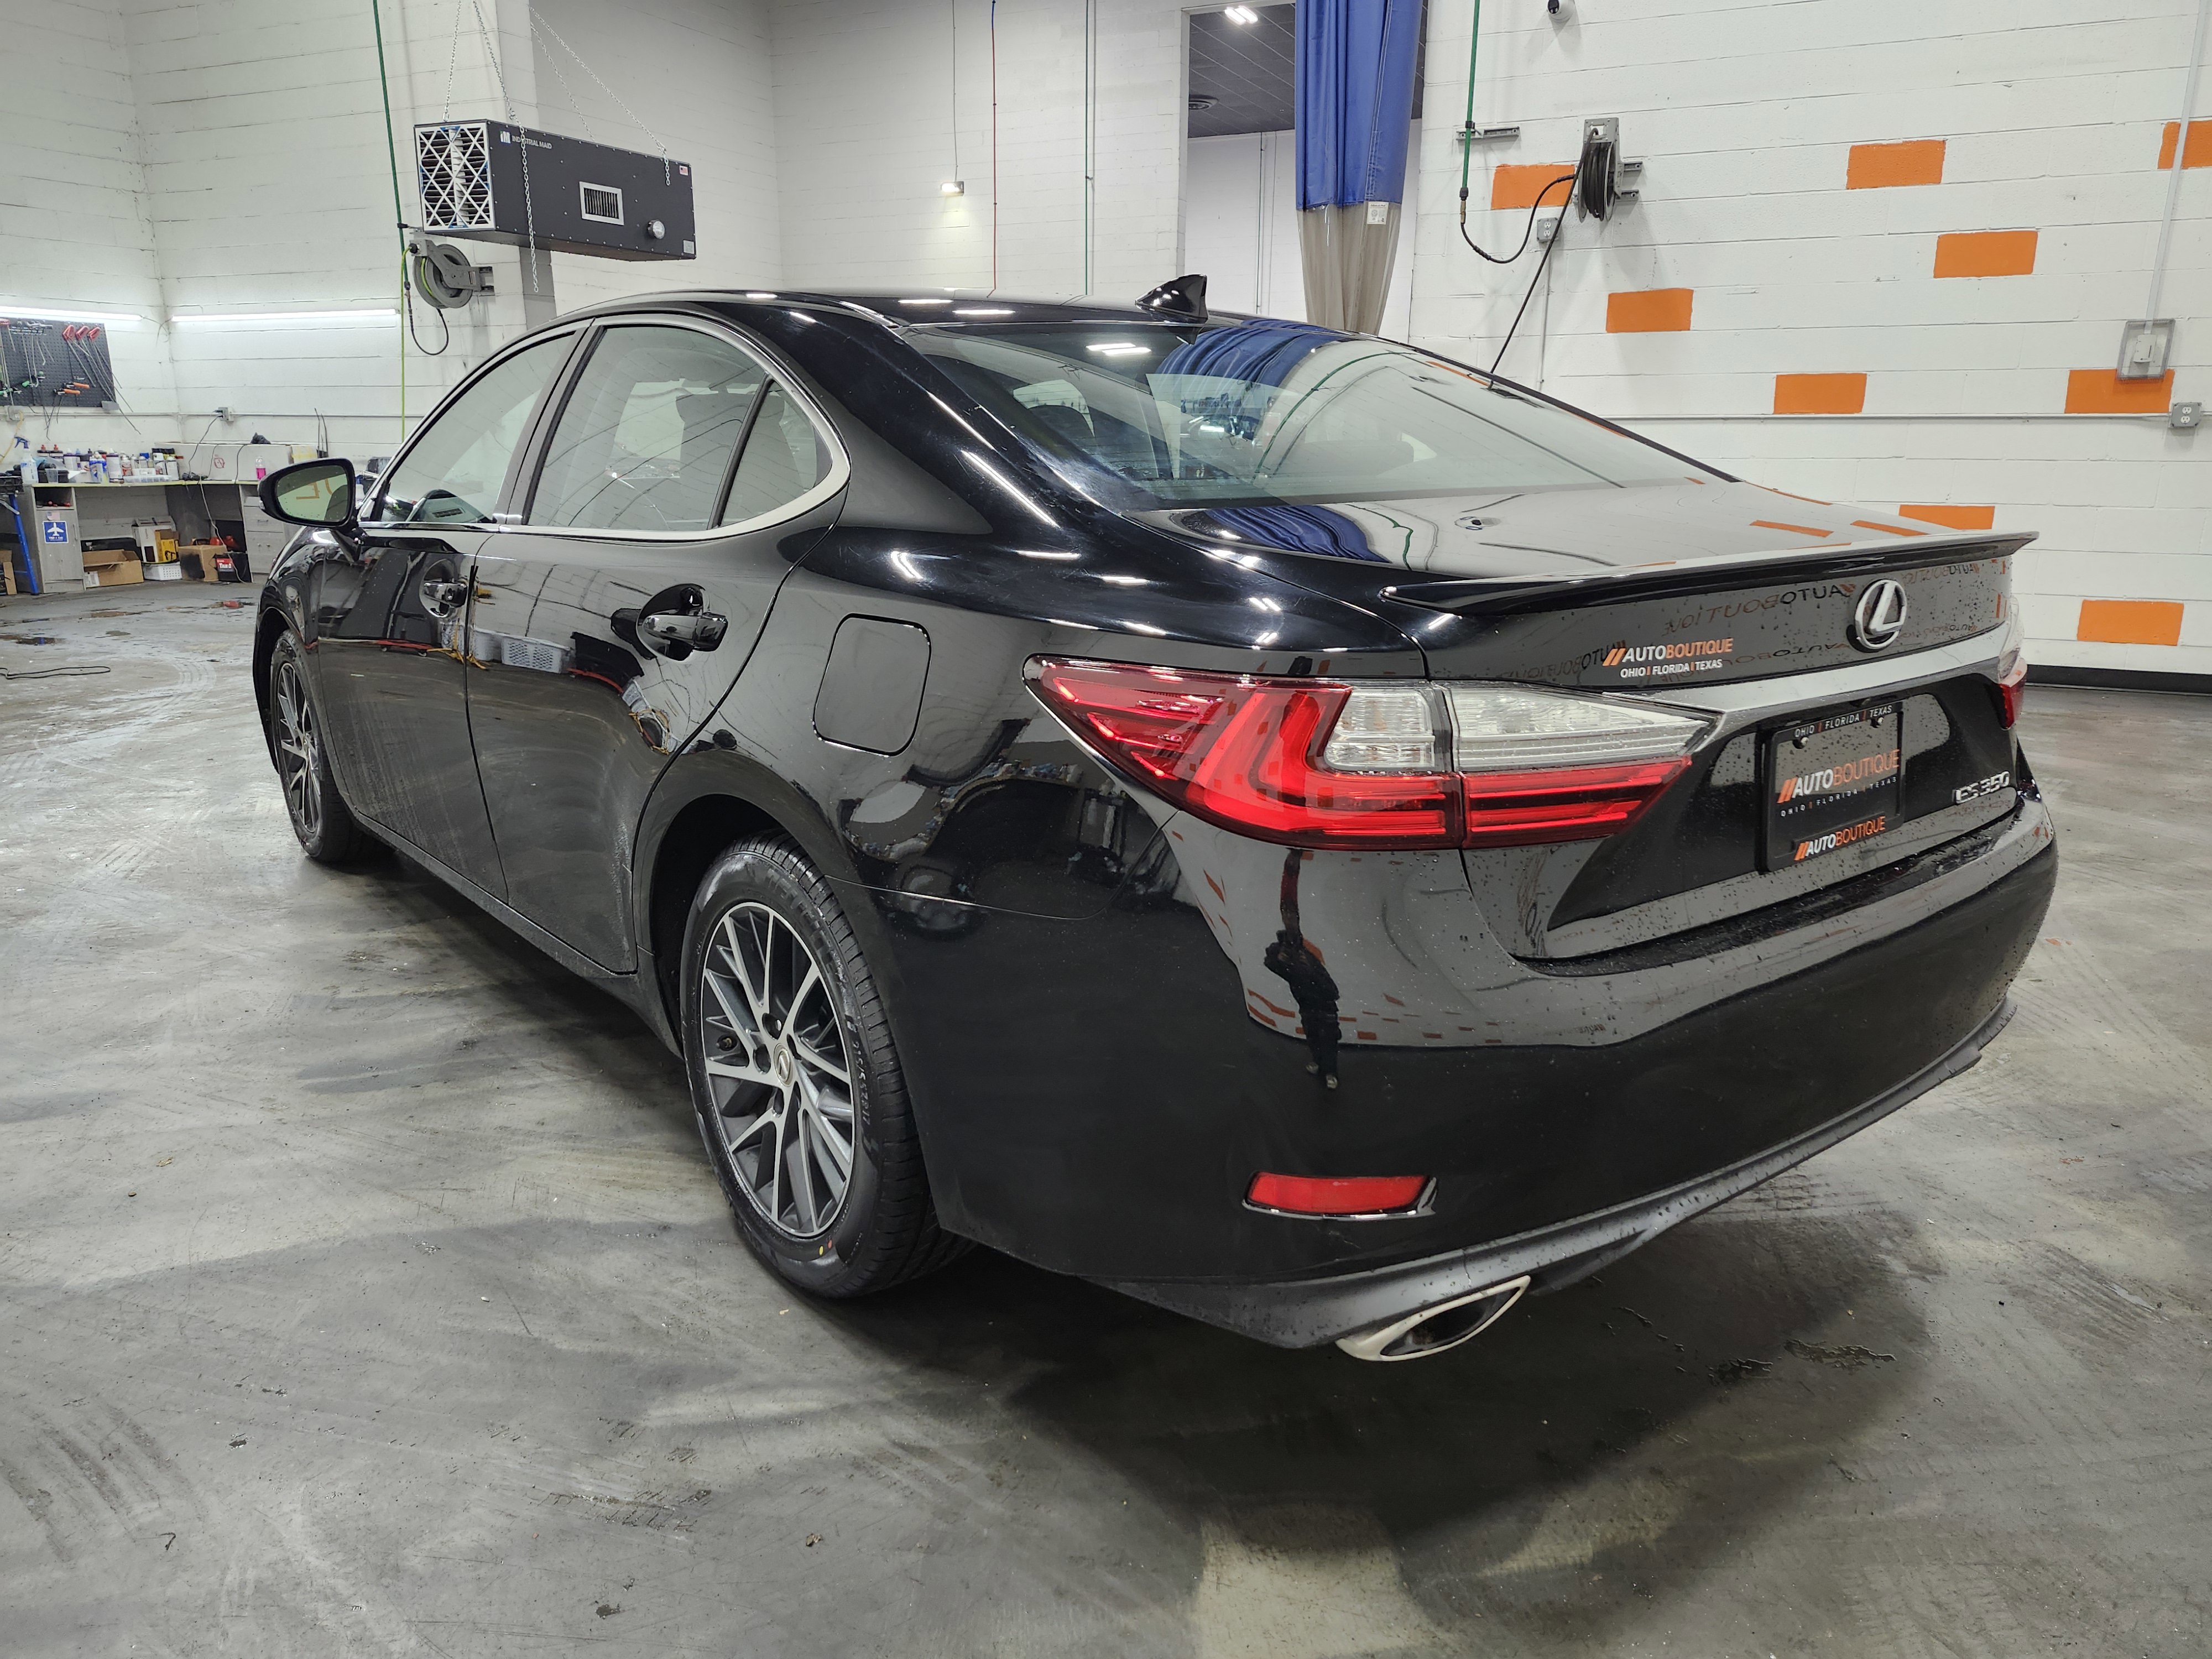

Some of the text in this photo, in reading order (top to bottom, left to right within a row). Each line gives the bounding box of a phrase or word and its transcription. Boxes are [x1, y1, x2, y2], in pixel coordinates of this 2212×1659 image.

[512, 135, 552, 149] INDSTRIAL MAID
[1621, 637, 1734, 663] AUTOBOUTIQUE
[1619, 659, 1723, 679] OHIO FLORIDA TEXAS
[1794, 705, 1892, 738] OHIO FLORIDA TEXAS
[1792, 749, 1900, 799] AUTOBOUTIQUE
[1780, 776, 1897, 817] OHIO FLORIDA TEXAS
[1805, 816, 1886, 857] AUTOBOUTIQUE
